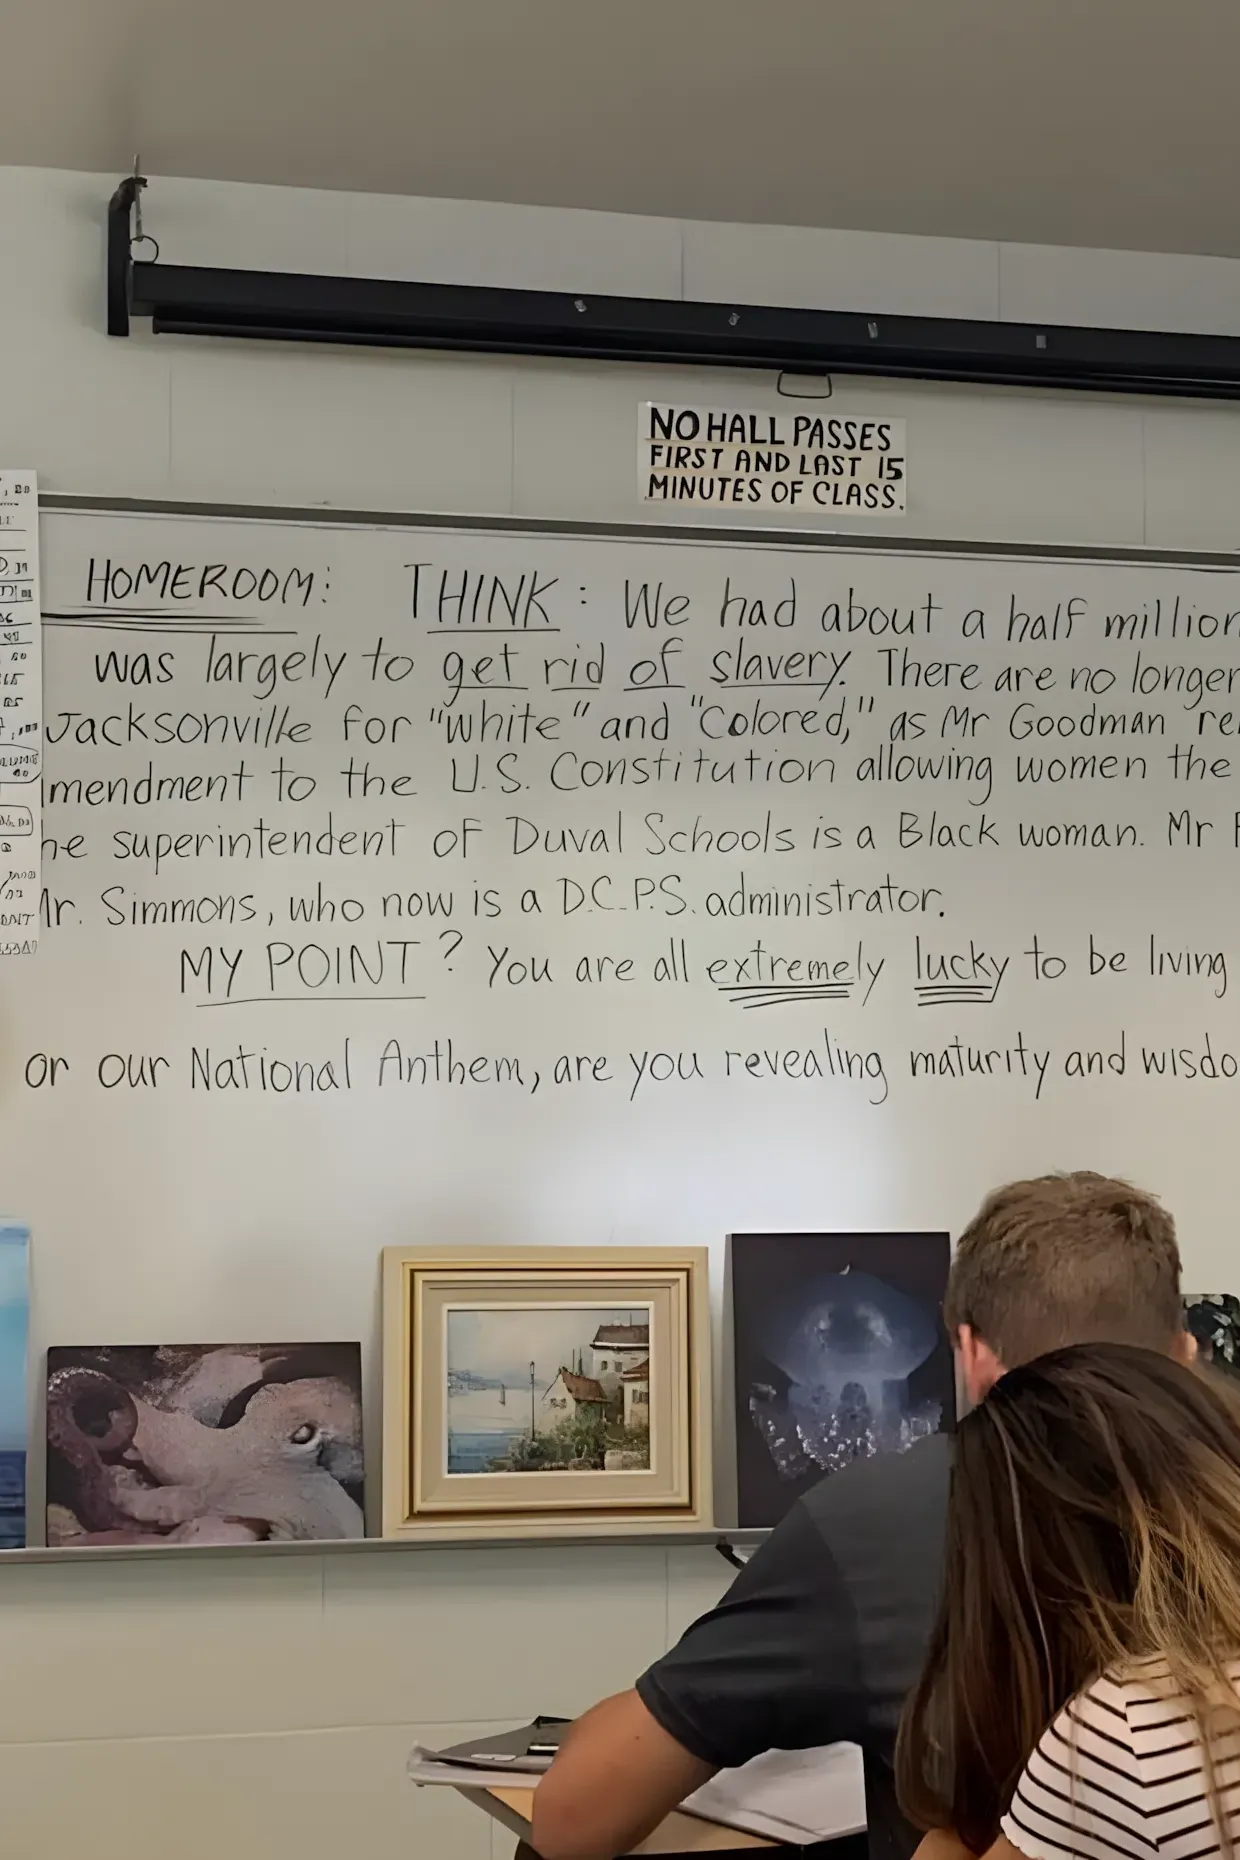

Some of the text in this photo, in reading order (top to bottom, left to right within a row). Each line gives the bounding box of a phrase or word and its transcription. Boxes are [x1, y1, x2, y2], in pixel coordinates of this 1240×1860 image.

[650, 407, 891, 451] NO HALL PASSES
[648, 474, 904, 510] MINUTES OF CLASS.
[651, 445, 904, 480] FIRST AND LAST 15
[86, 557, 331, 606] HOMEROOM:
[624, 577, 690, 629] We
[719, 576, 796, 627] had
[821, 588, 943, 638] about
[1007, 594, 1088, 643] half
[96, 654, 173, 685] was
[206, 635, 347, 700] largely
[443, 643, 519, 703] get
[543, 643, 603, 687] rid
[709, 638, 852, 702] slavery.
[878, 648, 982, 691] There
[995, 662, 1055, 693] are
[46, 703, 313, 747] Jacksonville
[344, 703, 411, 745] for
[429, 700, 589, 745] "white"
[601, 706, 670, 743] and
[1010, 704, 1166, 738] Goodman
[551, 750, 835, 786] Constitution
[856, 744, 993, 806] allowing
[1017, 752, 1147, 781] women
[113, 816, 405, 876] superintendent
[506, 815, 622, 857] Duval
[645, 813, 796, 855] Schools
[899, 812, 1001, 850] Black
[1018, 821, 1145, 848] woman.
[101, 872, 946, 929] Simmons, who now administrator.
[180, 947, 242, 997] MY
[266, 940, 421, 991] POINT
[487, 946, 553, 987] You
[575, 951, 634, 984] are
[653, 938, 688, 984] all
[706, 939, 886, 1008] extremely
[915, 935, 1009, 1004] lucky
[1151, 935, 1227, 998] living
[98, 1050, 170, 1089] our
[191, 1037, 351, 1093] National
[378, 1039, 541, 1094] Anthem,
[629, 1048, 703, 1100] you
[725, 1028, 888, 1105] revealing
[911, 1032, 1052, 1099] maturity
[1065, 1032, 1125, 1077] and
